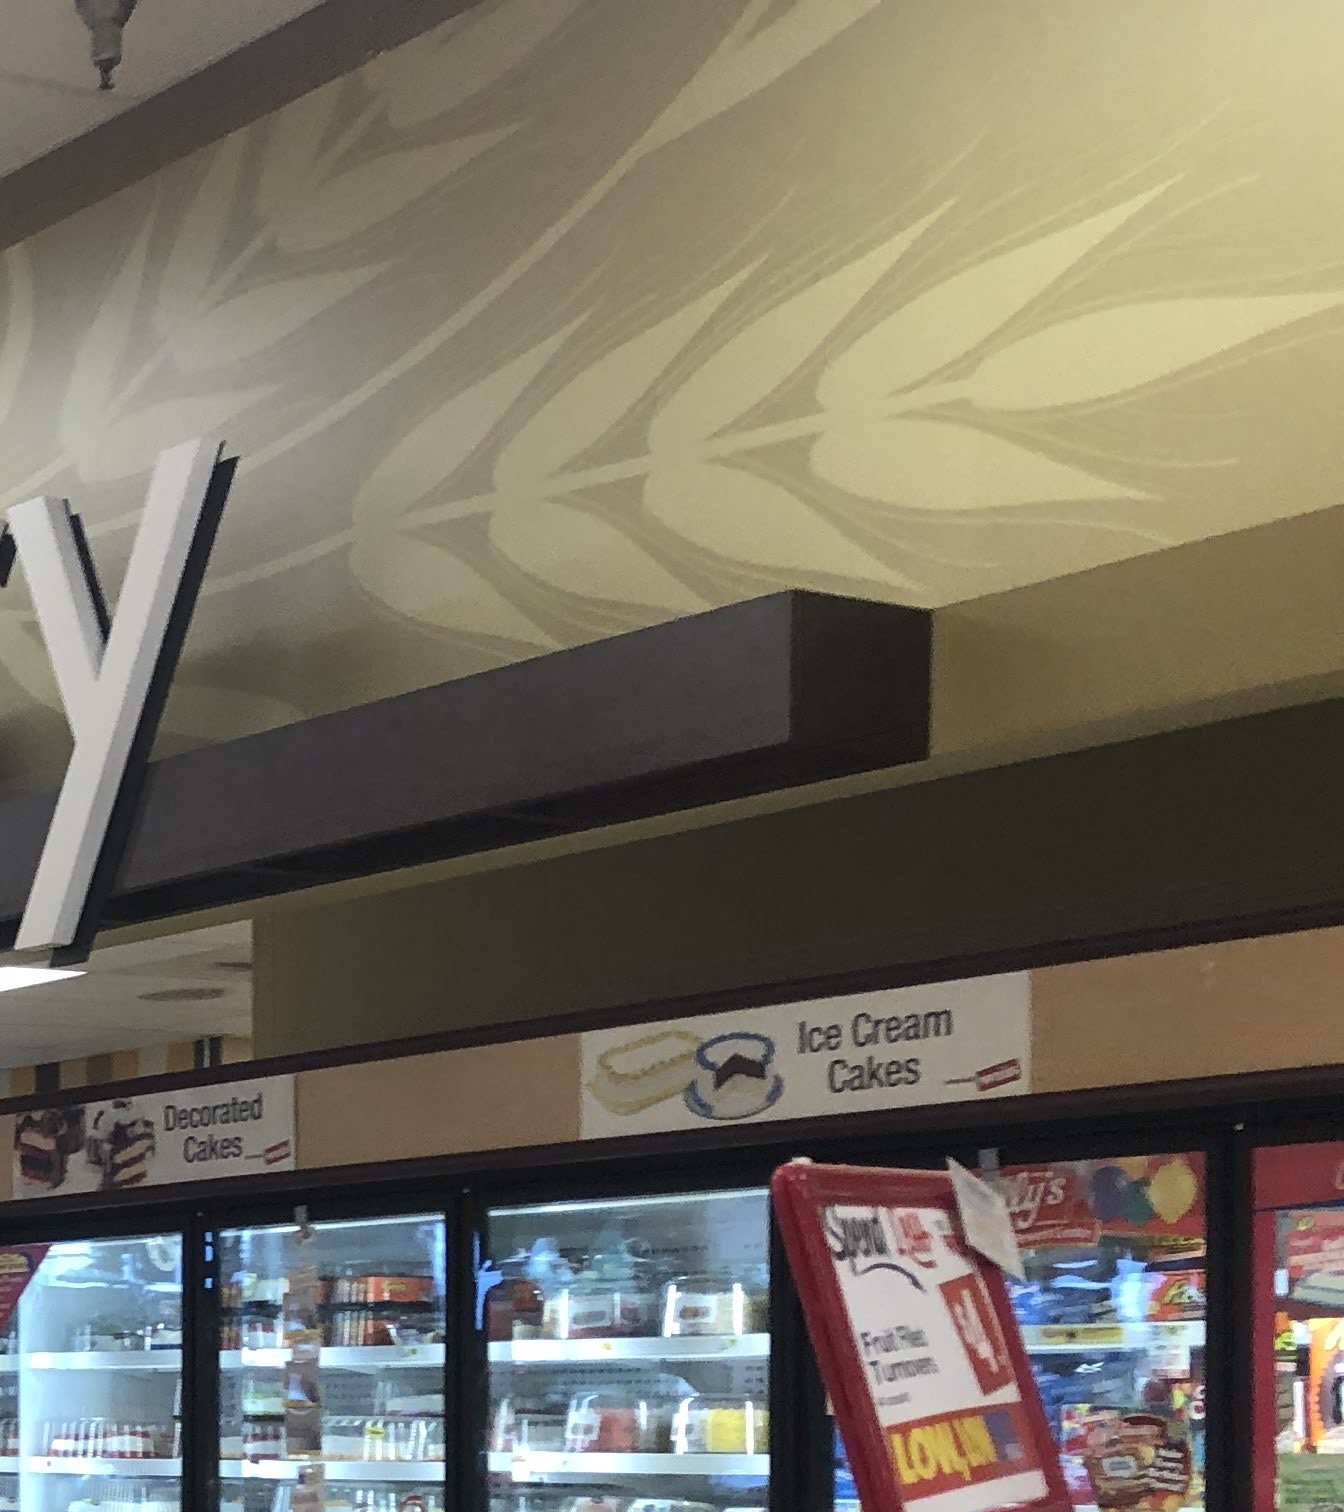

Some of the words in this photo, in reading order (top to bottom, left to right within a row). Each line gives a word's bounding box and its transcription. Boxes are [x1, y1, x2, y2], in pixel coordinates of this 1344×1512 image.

[797, 1020, 842, 1054] Ice
[851, 1009, 954, 1048] Cream
[828, 1056, 922, 1093] Cakes
[163, 1091, 264, 1132] Decorated
[183, 1134, 243, 1163] Cakes
